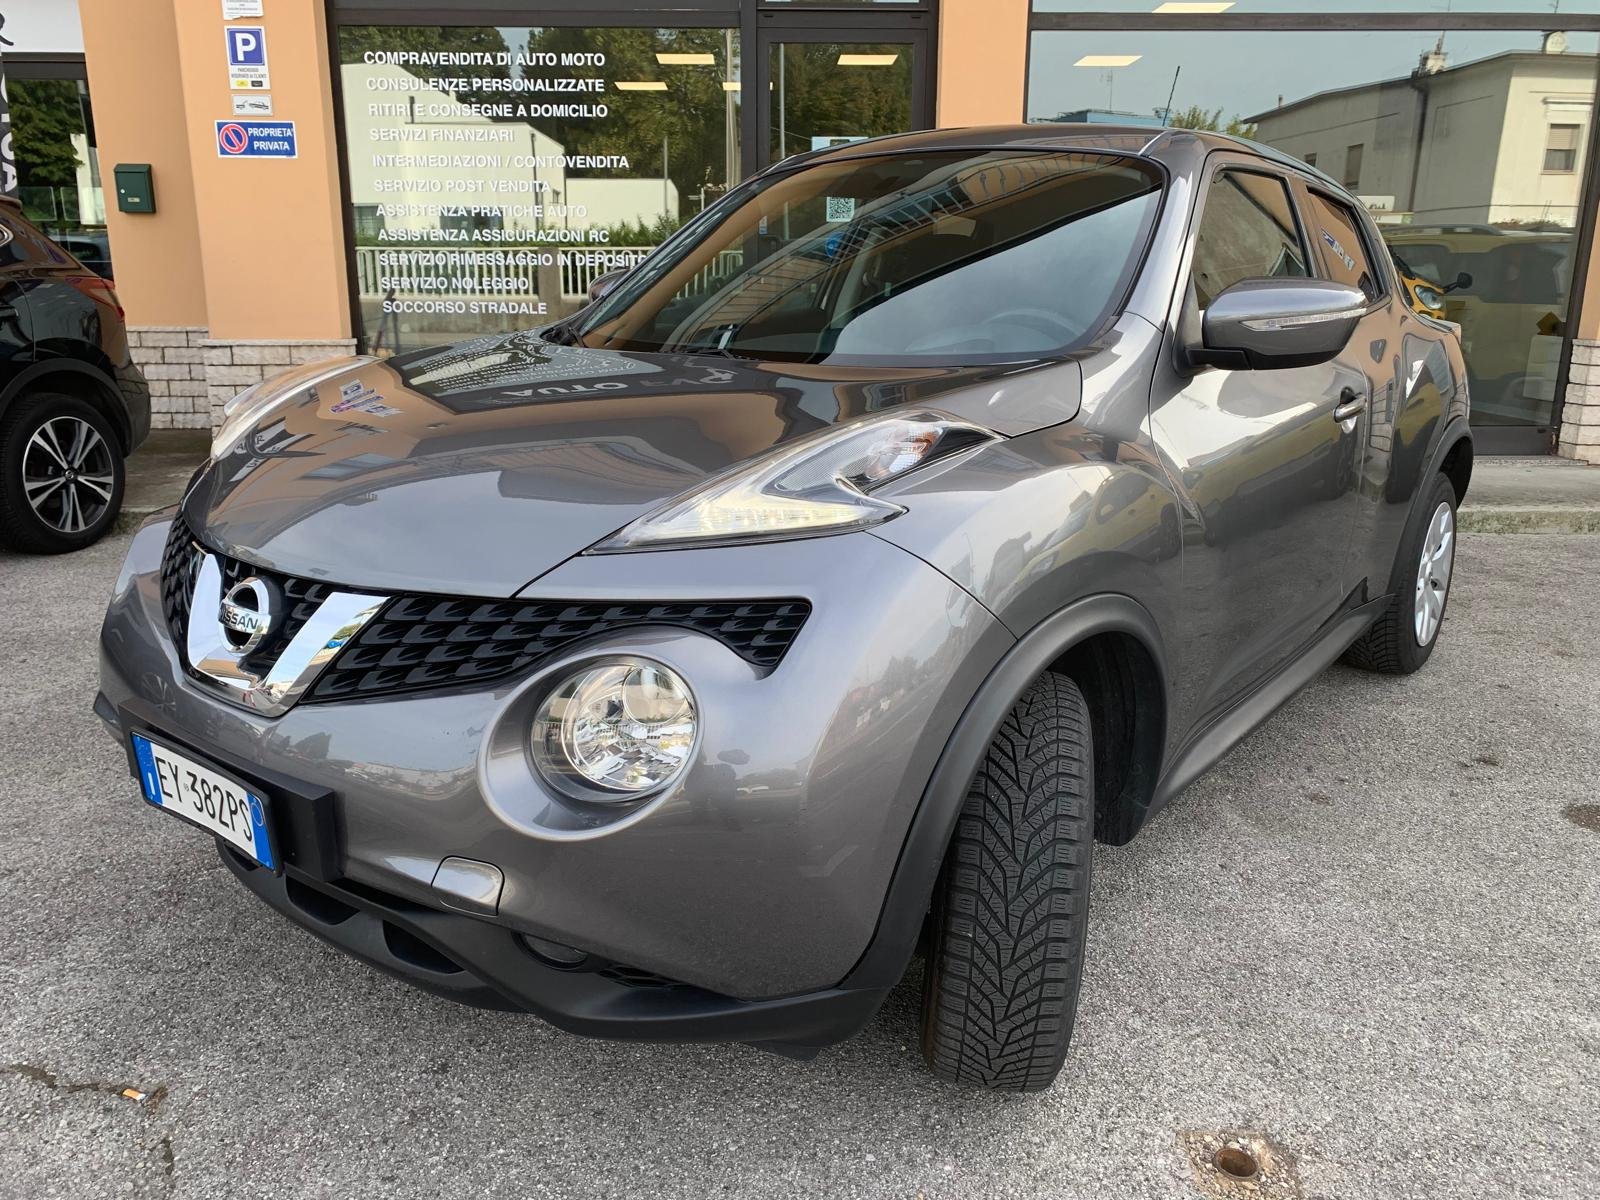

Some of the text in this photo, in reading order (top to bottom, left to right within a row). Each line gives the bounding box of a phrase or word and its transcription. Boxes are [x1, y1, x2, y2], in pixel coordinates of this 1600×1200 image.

[235, 33, 257, 61] P
[363, 51, 605, 66] COMPRAVENDITA DI AUTO MOTO
[366, 78, 605, 92] CONSULENZE PERSONALIZZATE
[368, 103, 608, 118] RITIRI E CONSEGNE A DOMICILIO
[370, 128, 514, 142] SERVIZI FINANZIARI
[253, 141, 290, 151] PRIVATA
[372, 155, 501, 168] INTERMEDIAZIONI
[514, 155, 630, 169] CONTOVENDITA
[374, 180, 551, 193] SERVIZIO POST VENDITA
[376, 204, 587, 218] ASSISTENZA PRATICHE AUTO
[378, 229, 609, 243] ASSISTENZA ASSICURAZIONI RC
[380, 253, 447, 266] SERVIZIO
[450, 253, 553, 266] RIMESSAGGIO
[557, 254, 572, 266] IN
[381, 277, 529, 290] SERVIZIO NOLEGGIO
[382, 301, 547, 315] SOCCORSO STRADALE
[155, 755, 253, 843] EY 382PS
